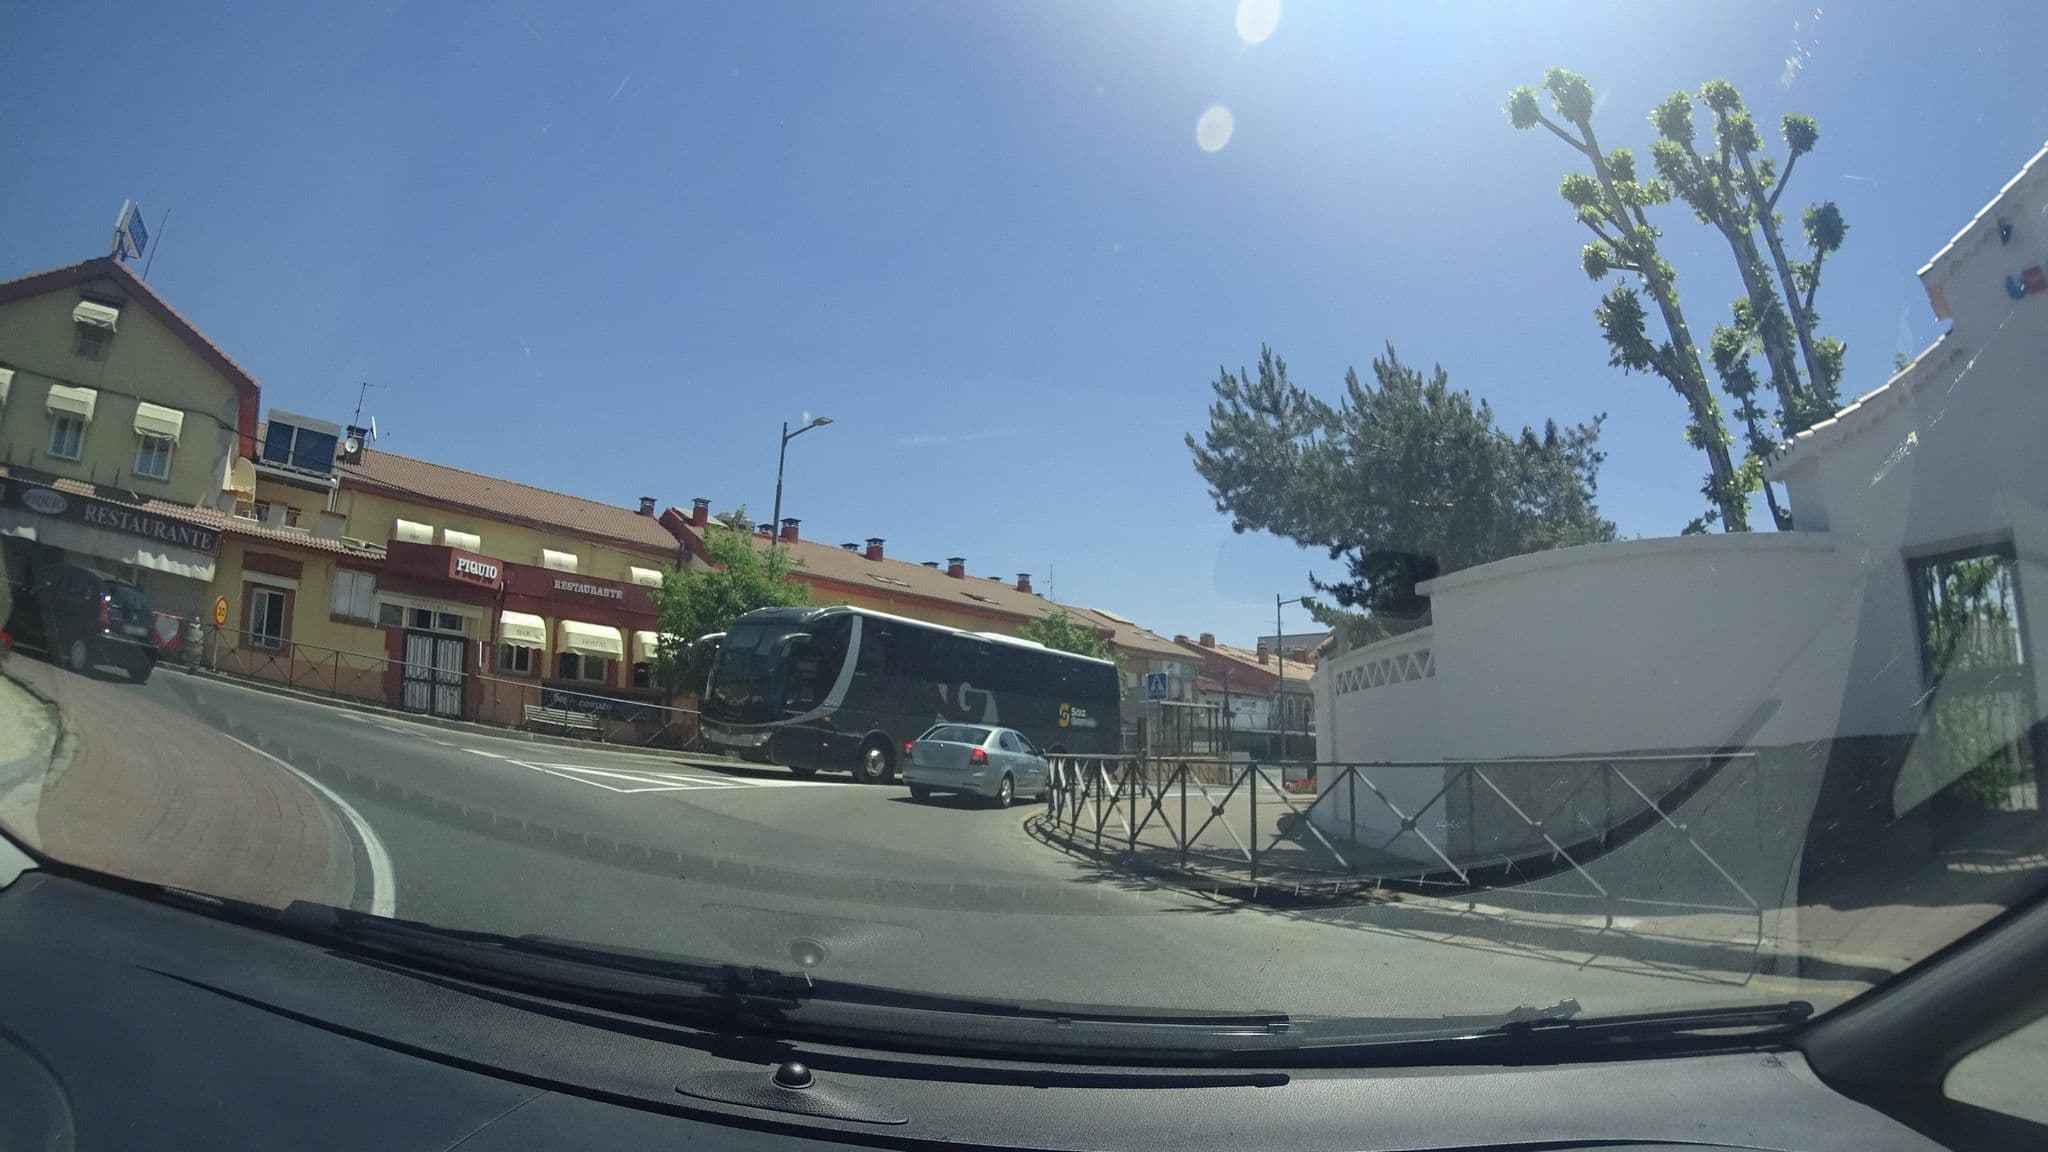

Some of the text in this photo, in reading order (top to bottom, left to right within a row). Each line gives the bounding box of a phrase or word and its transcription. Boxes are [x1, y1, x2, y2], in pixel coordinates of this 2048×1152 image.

[84, 503, 212, 549] RESTAURANTE
[457, 557, 497, 580] PIQUIO
[554, 579, 623, 600] RESTAURANTE
